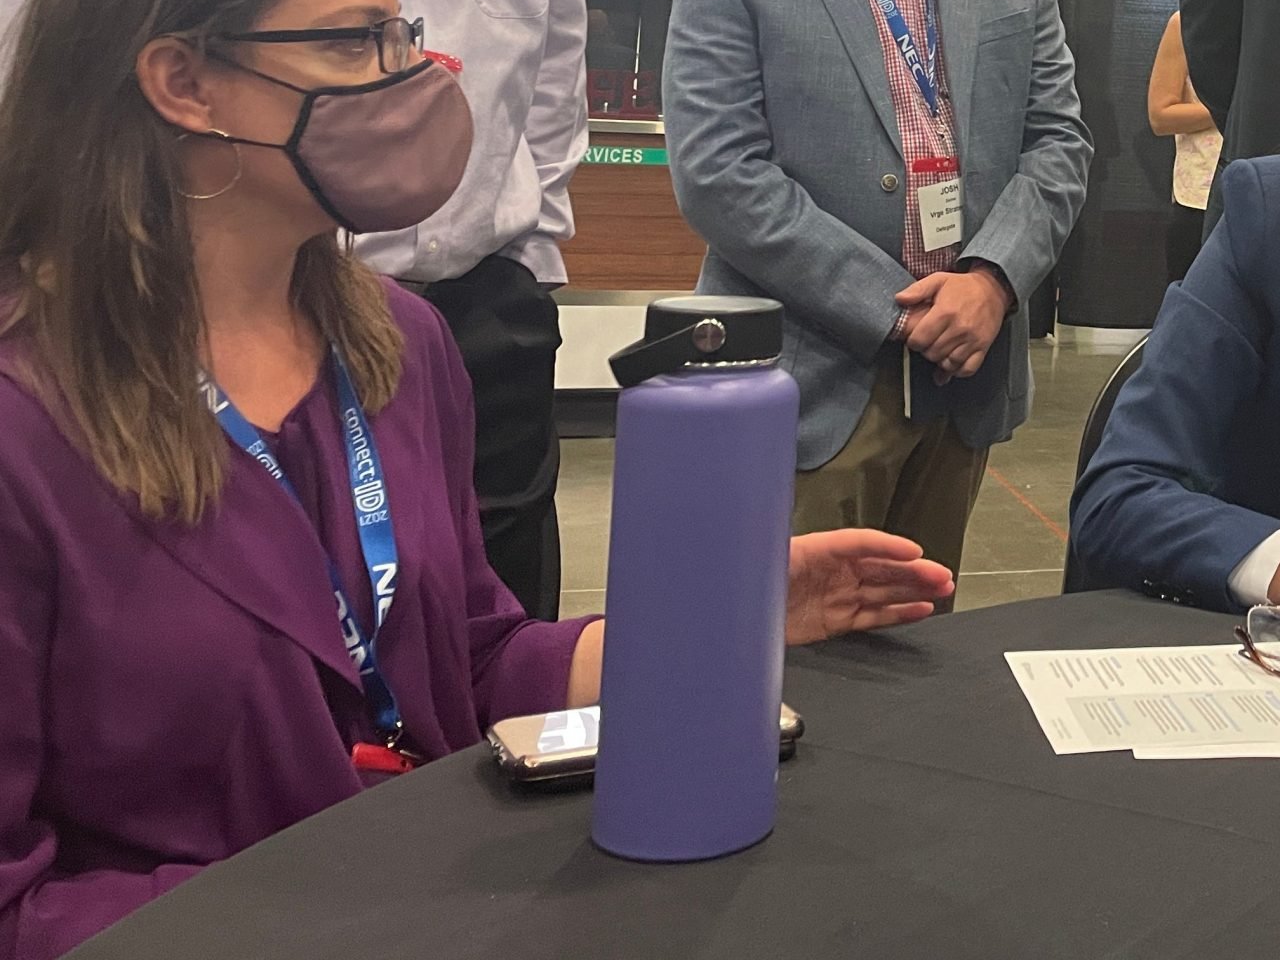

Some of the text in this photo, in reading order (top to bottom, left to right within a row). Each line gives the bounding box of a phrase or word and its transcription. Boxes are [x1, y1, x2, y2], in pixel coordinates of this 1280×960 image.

[897, 34, 924, 81] NEC
[345, 407, 386, 513] connect:ID
[359, 509, 389, 527] 2021
